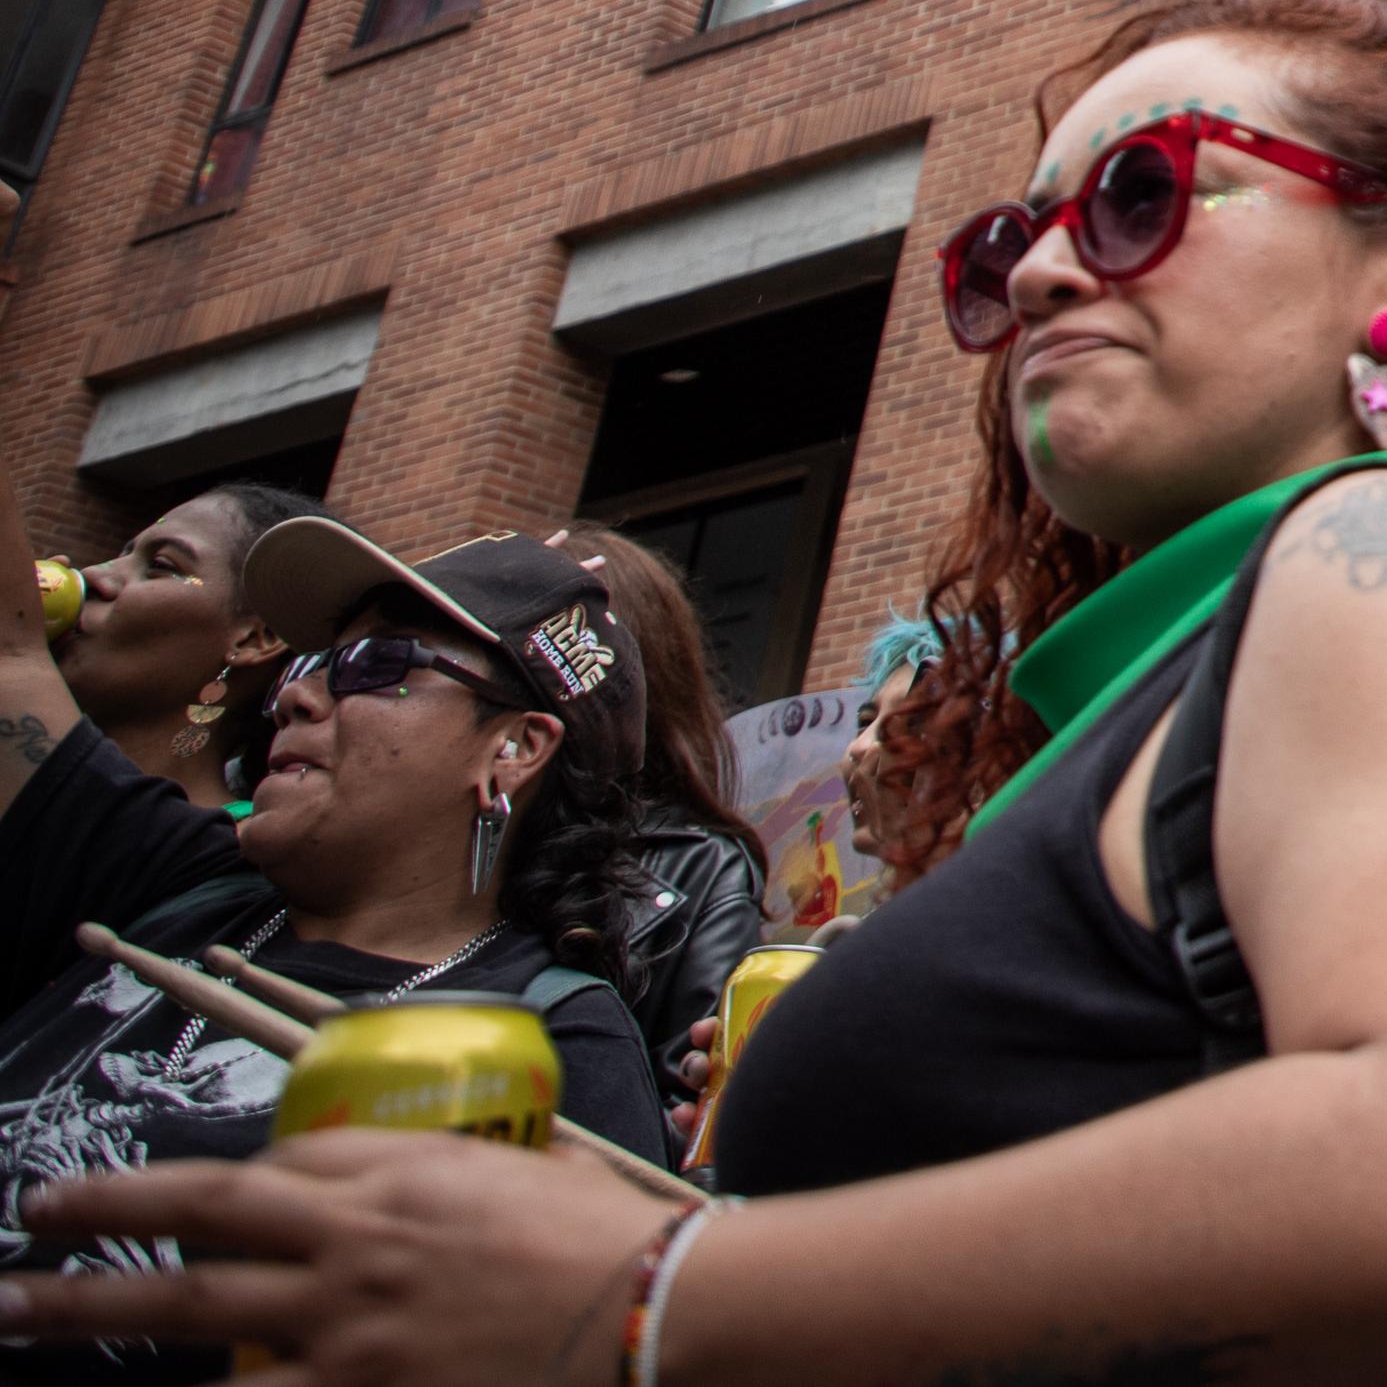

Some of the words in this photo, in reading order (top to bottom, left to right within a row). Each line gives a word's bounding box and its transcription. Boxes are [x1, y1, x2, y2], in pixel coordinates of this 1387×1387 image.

[532, 628, 563, 669] HOME
[561, 661, 585, 694] RUN
[540, 612, 606, 693] ACME
